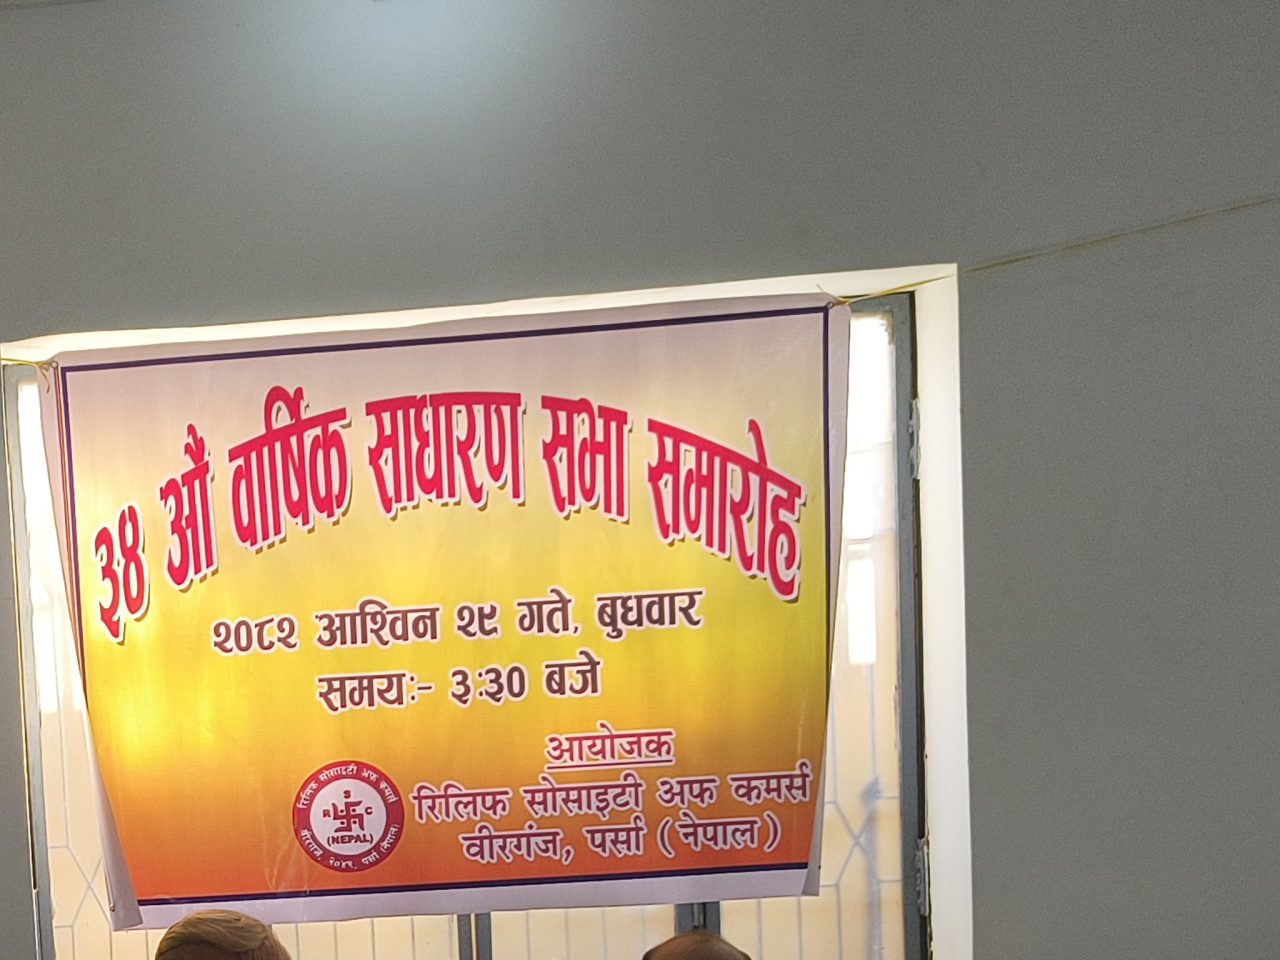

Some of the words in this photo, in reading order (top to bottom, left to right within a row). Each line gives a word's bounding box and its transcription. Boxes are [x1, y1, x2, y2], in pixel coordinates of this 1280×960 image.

[94, 504, 147, 640] ३४
[228, 385, 350, 549] वार्षिक
[365, 391, 523, 515] साधारण
[541, 394, 629, 519] सभा
[647, 418, 803, 597] समारोह
[213, 616, 297, 653] २०८२
[315, 599, 440, 647] आश्विन
[457, 604, 499, 637] २९
[517, 588, 579, 635] गते,
[597, 591, 703, 639] बुधवार
[545, 650, 600, 695] बजे
[547, 722, 673, 763] आयोजक
[365, 807, 373, 815] C
[411, 783, 509, 820] रिलिफ
[522, 773, 643, 818] सोसाइटी
[658, 778, 717, 805] अफ
[730, 762, 810, 801] कमर्स
[327, 833, 374, 847] (NEPAL)
[461, 823, 572, 862] वीरगंज,
[585, 815, 644, 854] पर्सा
